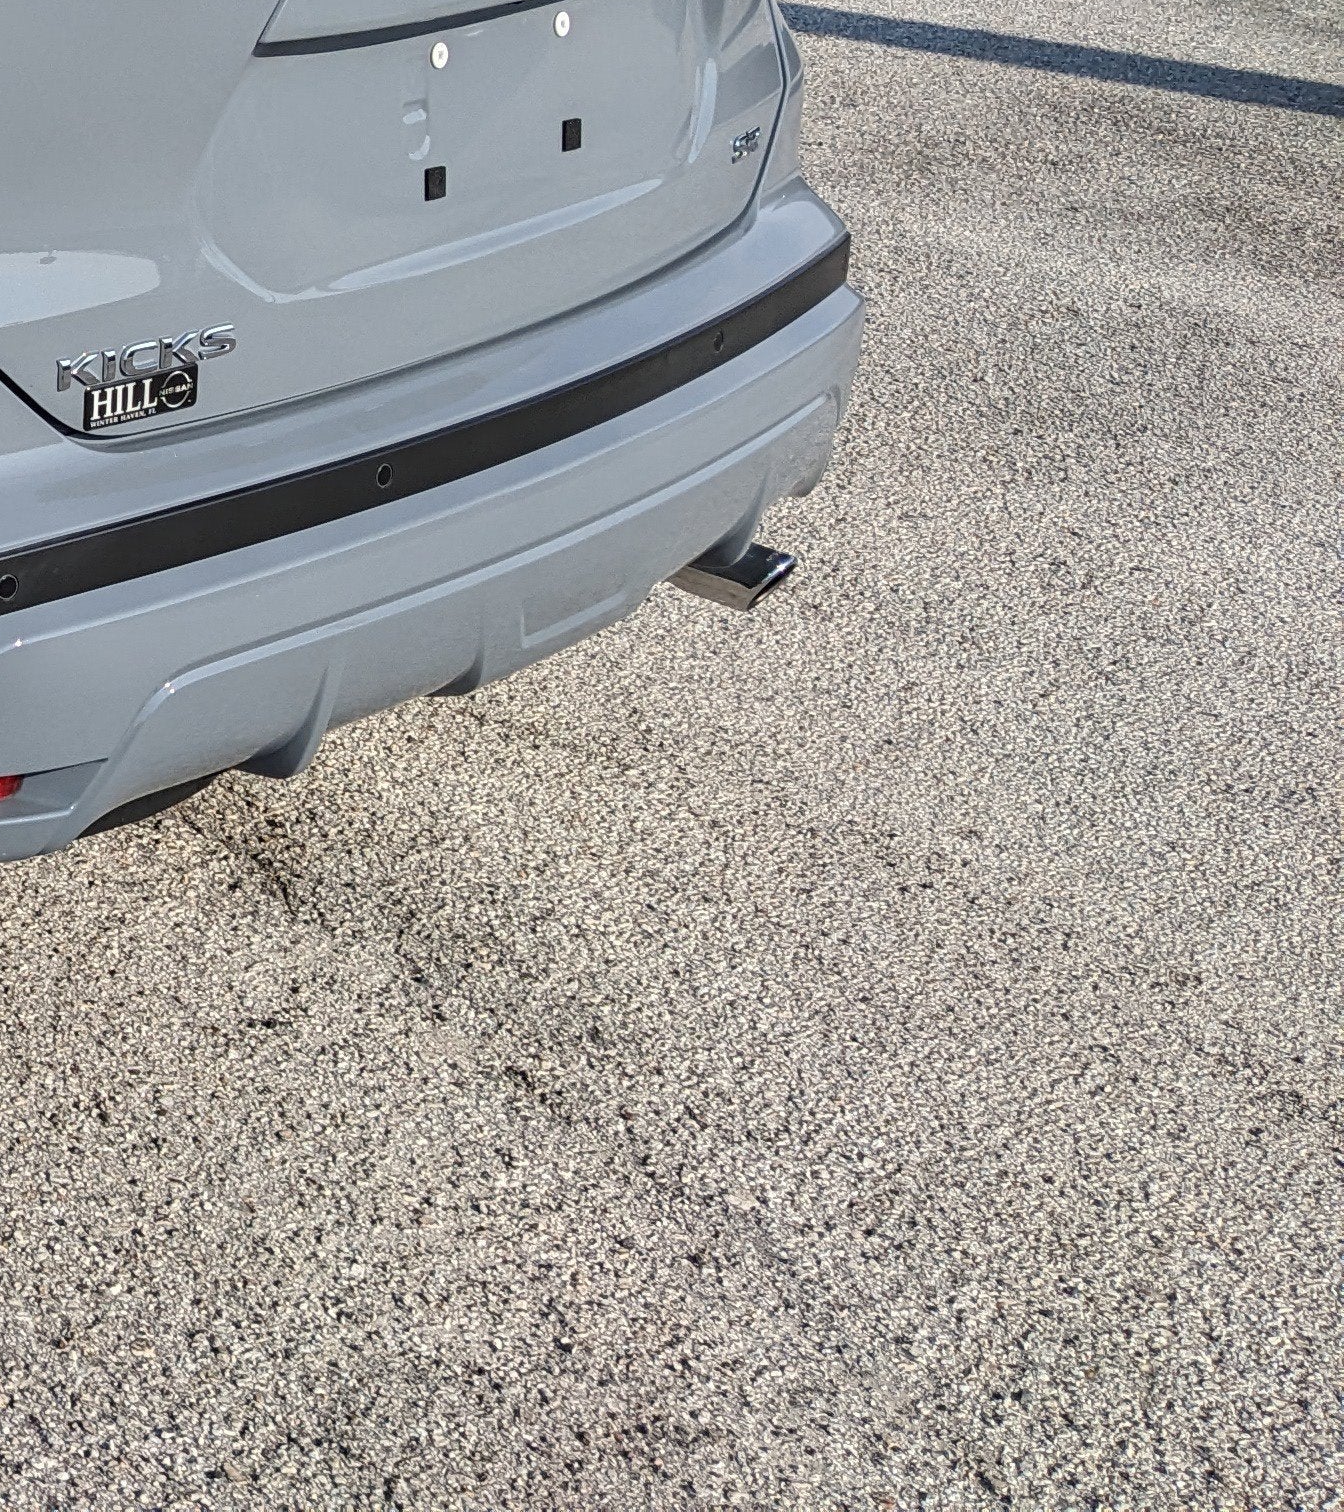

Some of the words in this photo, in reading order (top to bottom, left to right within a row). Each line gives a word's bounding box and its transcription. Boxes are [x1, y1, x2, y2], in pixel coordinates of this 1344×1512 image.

[56, 321, 237, 392] KICKS
[90, 378, 158, 421] HILL
[158, 381, 195, 397] NISSAN
[89, 416, 119, 429] WINTER
[148, 407, 157, 416] FL
